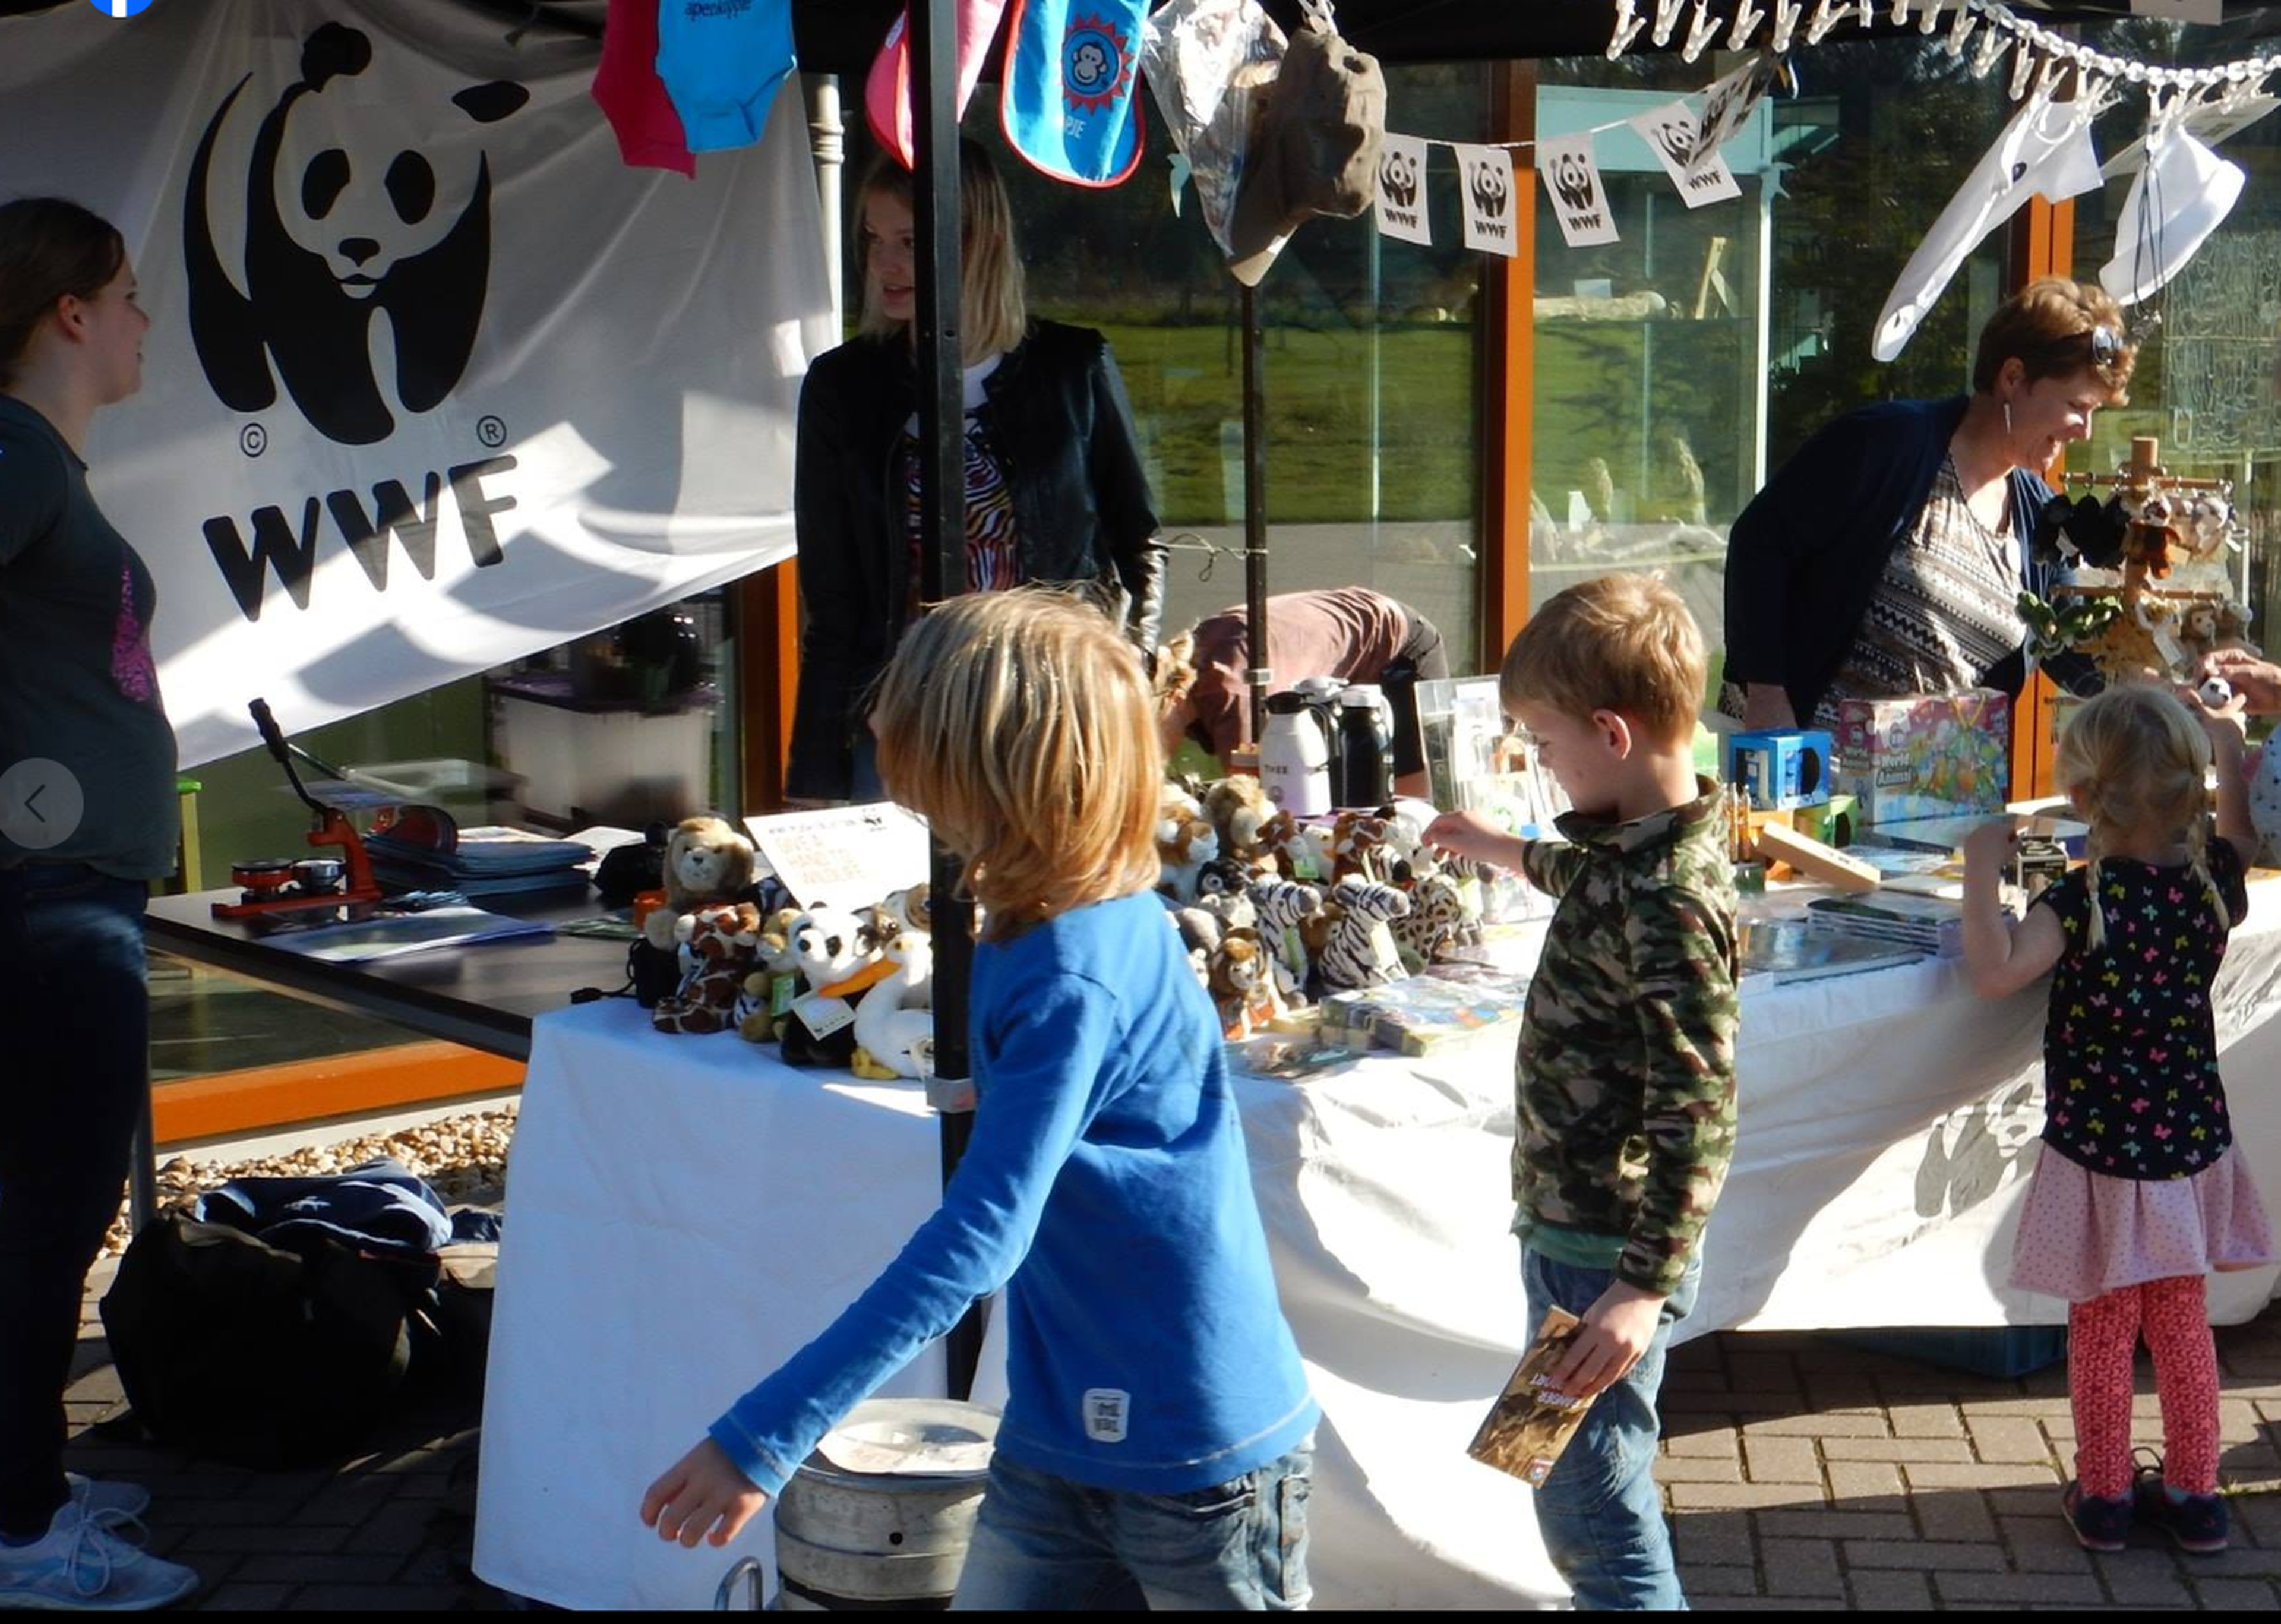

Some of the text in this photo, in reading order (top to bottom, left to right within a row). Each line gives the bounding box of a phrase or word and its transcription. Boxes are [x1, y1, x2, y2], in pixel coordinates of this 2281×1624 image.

[1690, 170, 1722, 191] WWF
[1384, 208, 1418, 229] WWF
[1568, 214, 1601, 232] WWF
[1474, 220, 1508, 240] WWF
[203, 454, 517, 622] WWF
